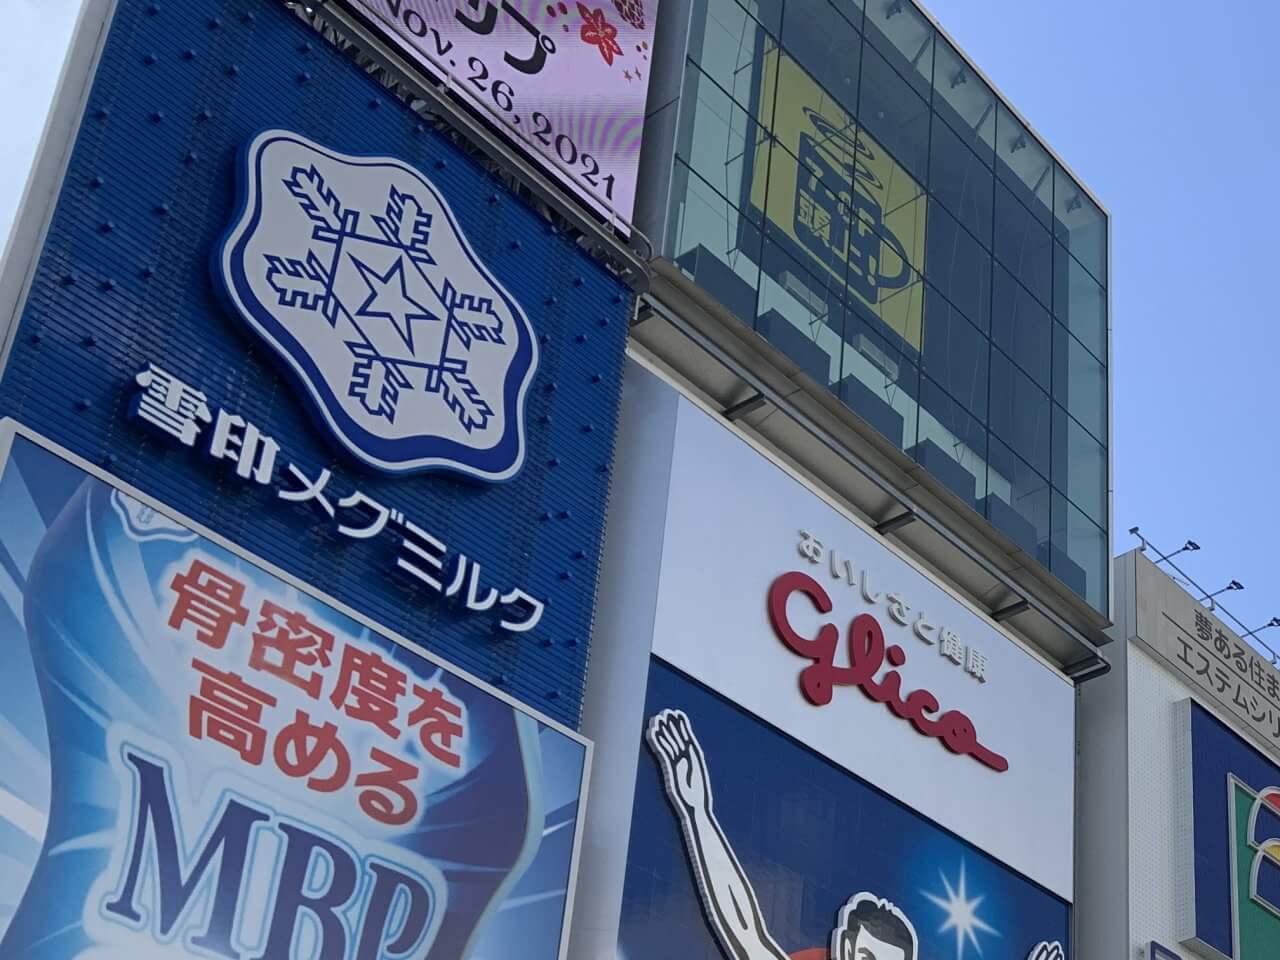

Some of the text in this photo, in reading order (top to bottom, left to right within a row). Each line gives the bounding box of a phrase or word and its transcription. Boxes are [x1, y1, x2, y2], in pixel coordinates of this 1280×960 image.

[467, 56, 521, 124] 26,
[532, 111, 616, 201] 2021
[135, 361, 545, 633] 雪印メグミルク
[167, 558, 466, 768] 骨密度を
[768, 571, 1009, 773] Glico
[797, 528, 987, 683] おいしさと健康
[188, 657, 421, 826] 高める
